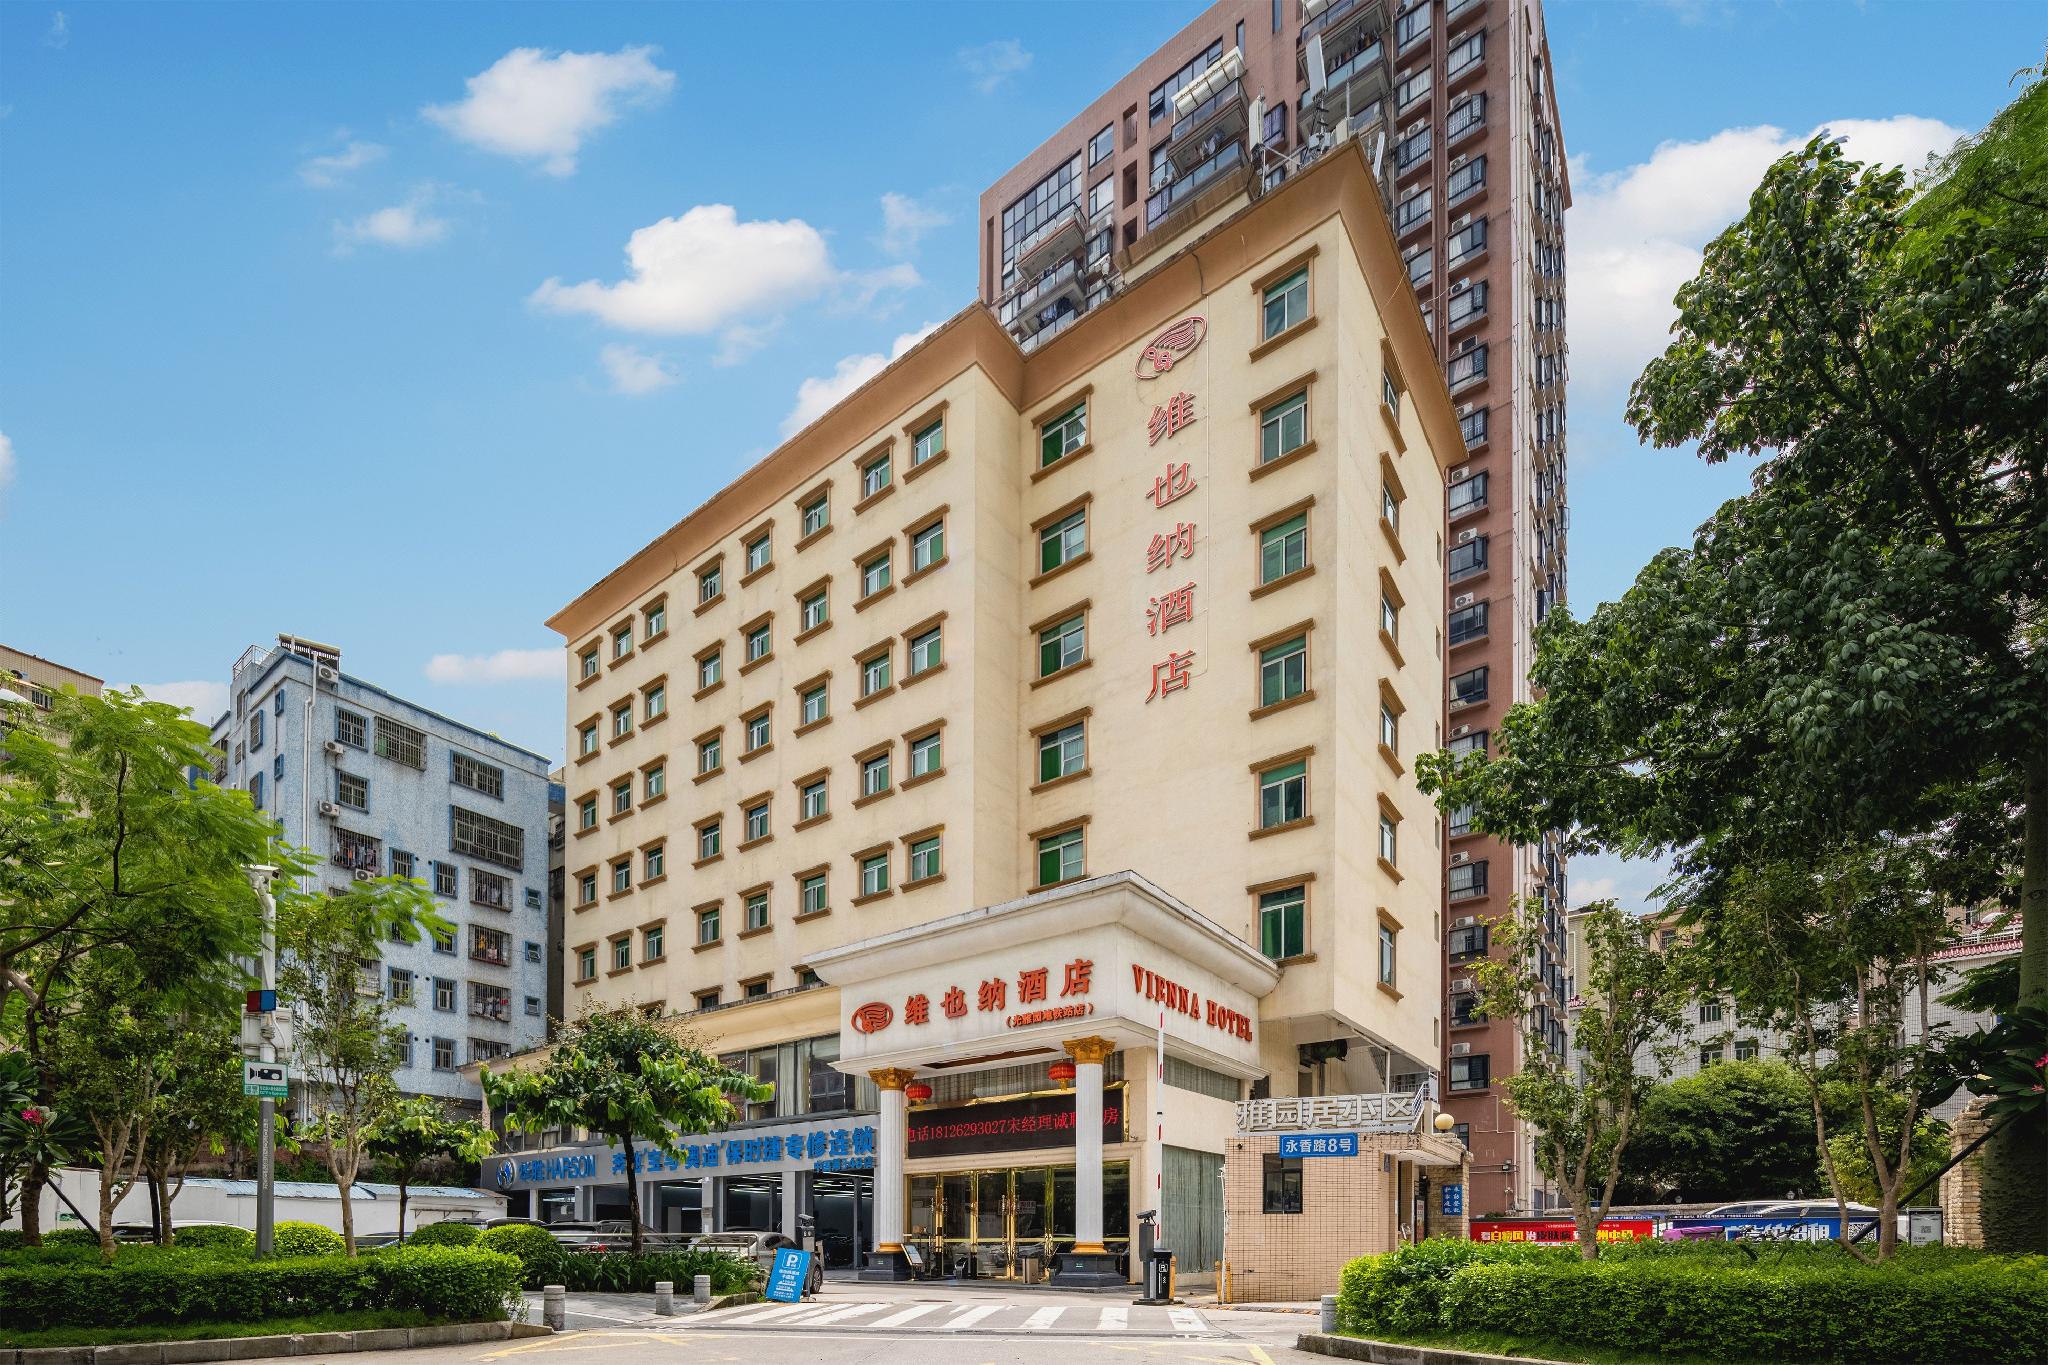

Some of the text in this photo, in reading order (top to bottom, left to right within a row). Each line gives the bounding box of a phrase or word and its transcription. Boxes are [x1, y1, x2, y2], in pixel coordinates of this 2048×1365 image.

[1145, 390, 1198, 704] 维也纳酒店
[903, 958, 1095, 1027] 维也纳酒店
[1131, 963, 1254, 1042] VIENNA HOTEL
[1235, 1092, 1416, 1130] 雅园居小区
[1285, 1137, 1353, 1154] 永香路8号
